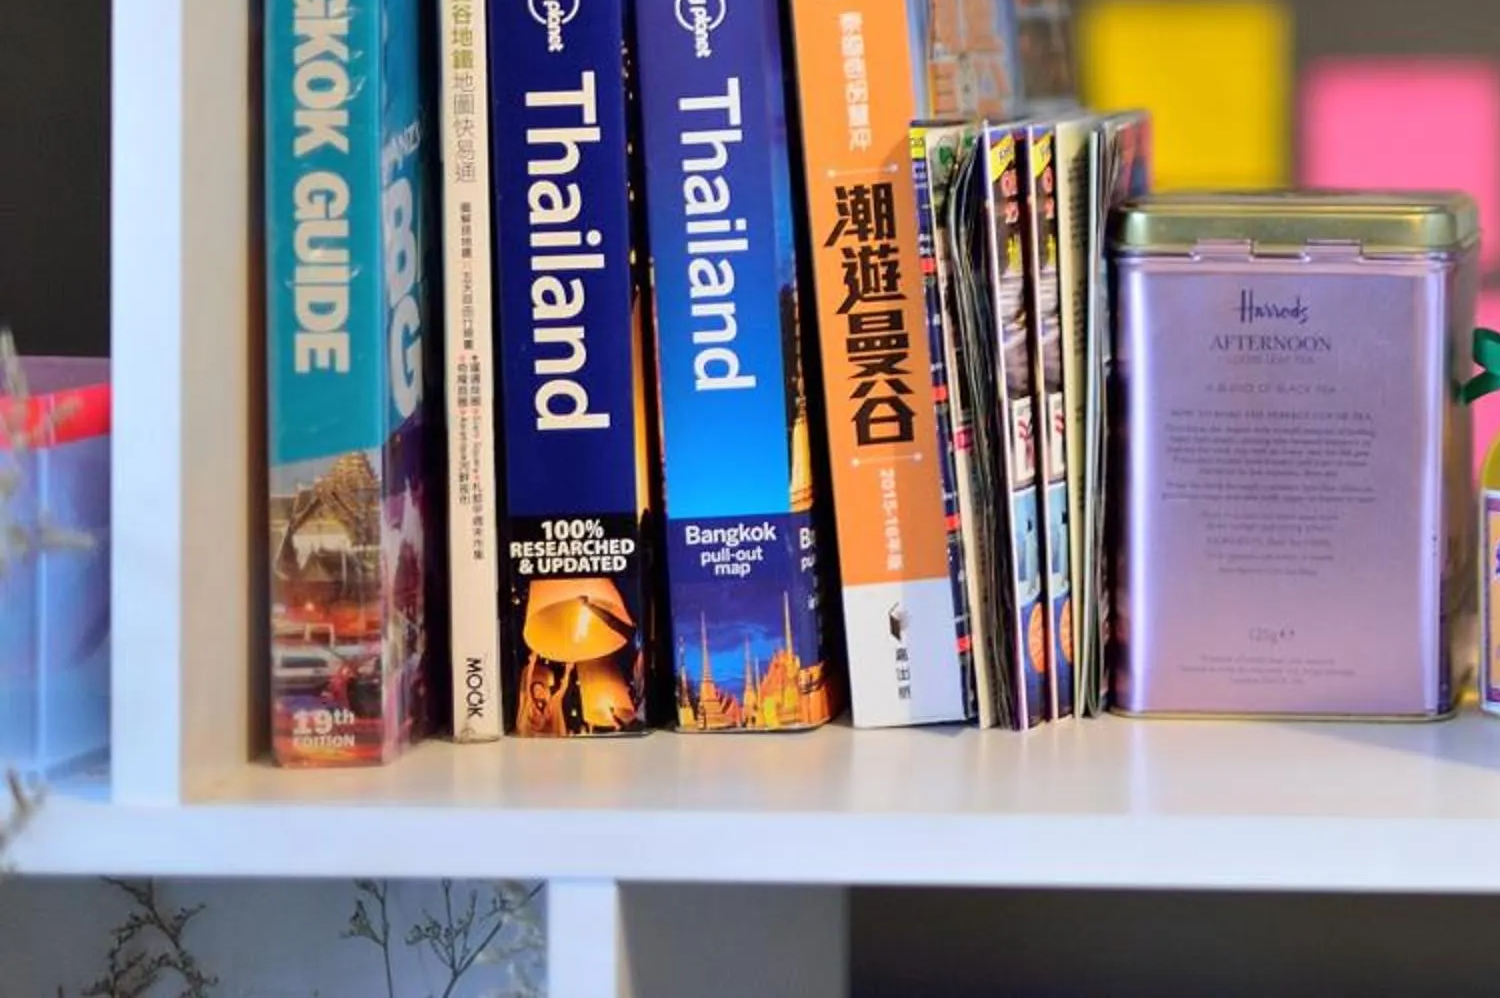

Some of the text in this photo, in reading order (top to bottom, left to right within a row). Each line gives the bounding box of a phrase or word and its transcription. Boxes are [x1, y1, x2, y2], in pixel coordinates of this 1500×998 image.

[543, 0, 565, 52] planet
[690, 6, 712, 58] planet
[679, 77, 757, 391] Thailand
[525, 71, 611, 432] Thailand
[293, 170, 350, 374] GUIDE
[824, 182, 919, 447] 潮遊曼谷
[1233, 288, 1311, 324] Harrods
[1209, 333, 1333, 351] AFTERNOON
[541, 519, 605, 540] 100%
[685, 522, 777, 547] Bangkok
[510, 538, 635, 558] RESEARCHED
[701, 546, 763, 567] pull-out
[518, 556, 628, 574] & UPDATED
[714, 562, 751, 578] map
[466, 658, 484, 719] MOOK
[293, 708, 355, 735] 19th
[293, 734, 355, 747] EDITION
